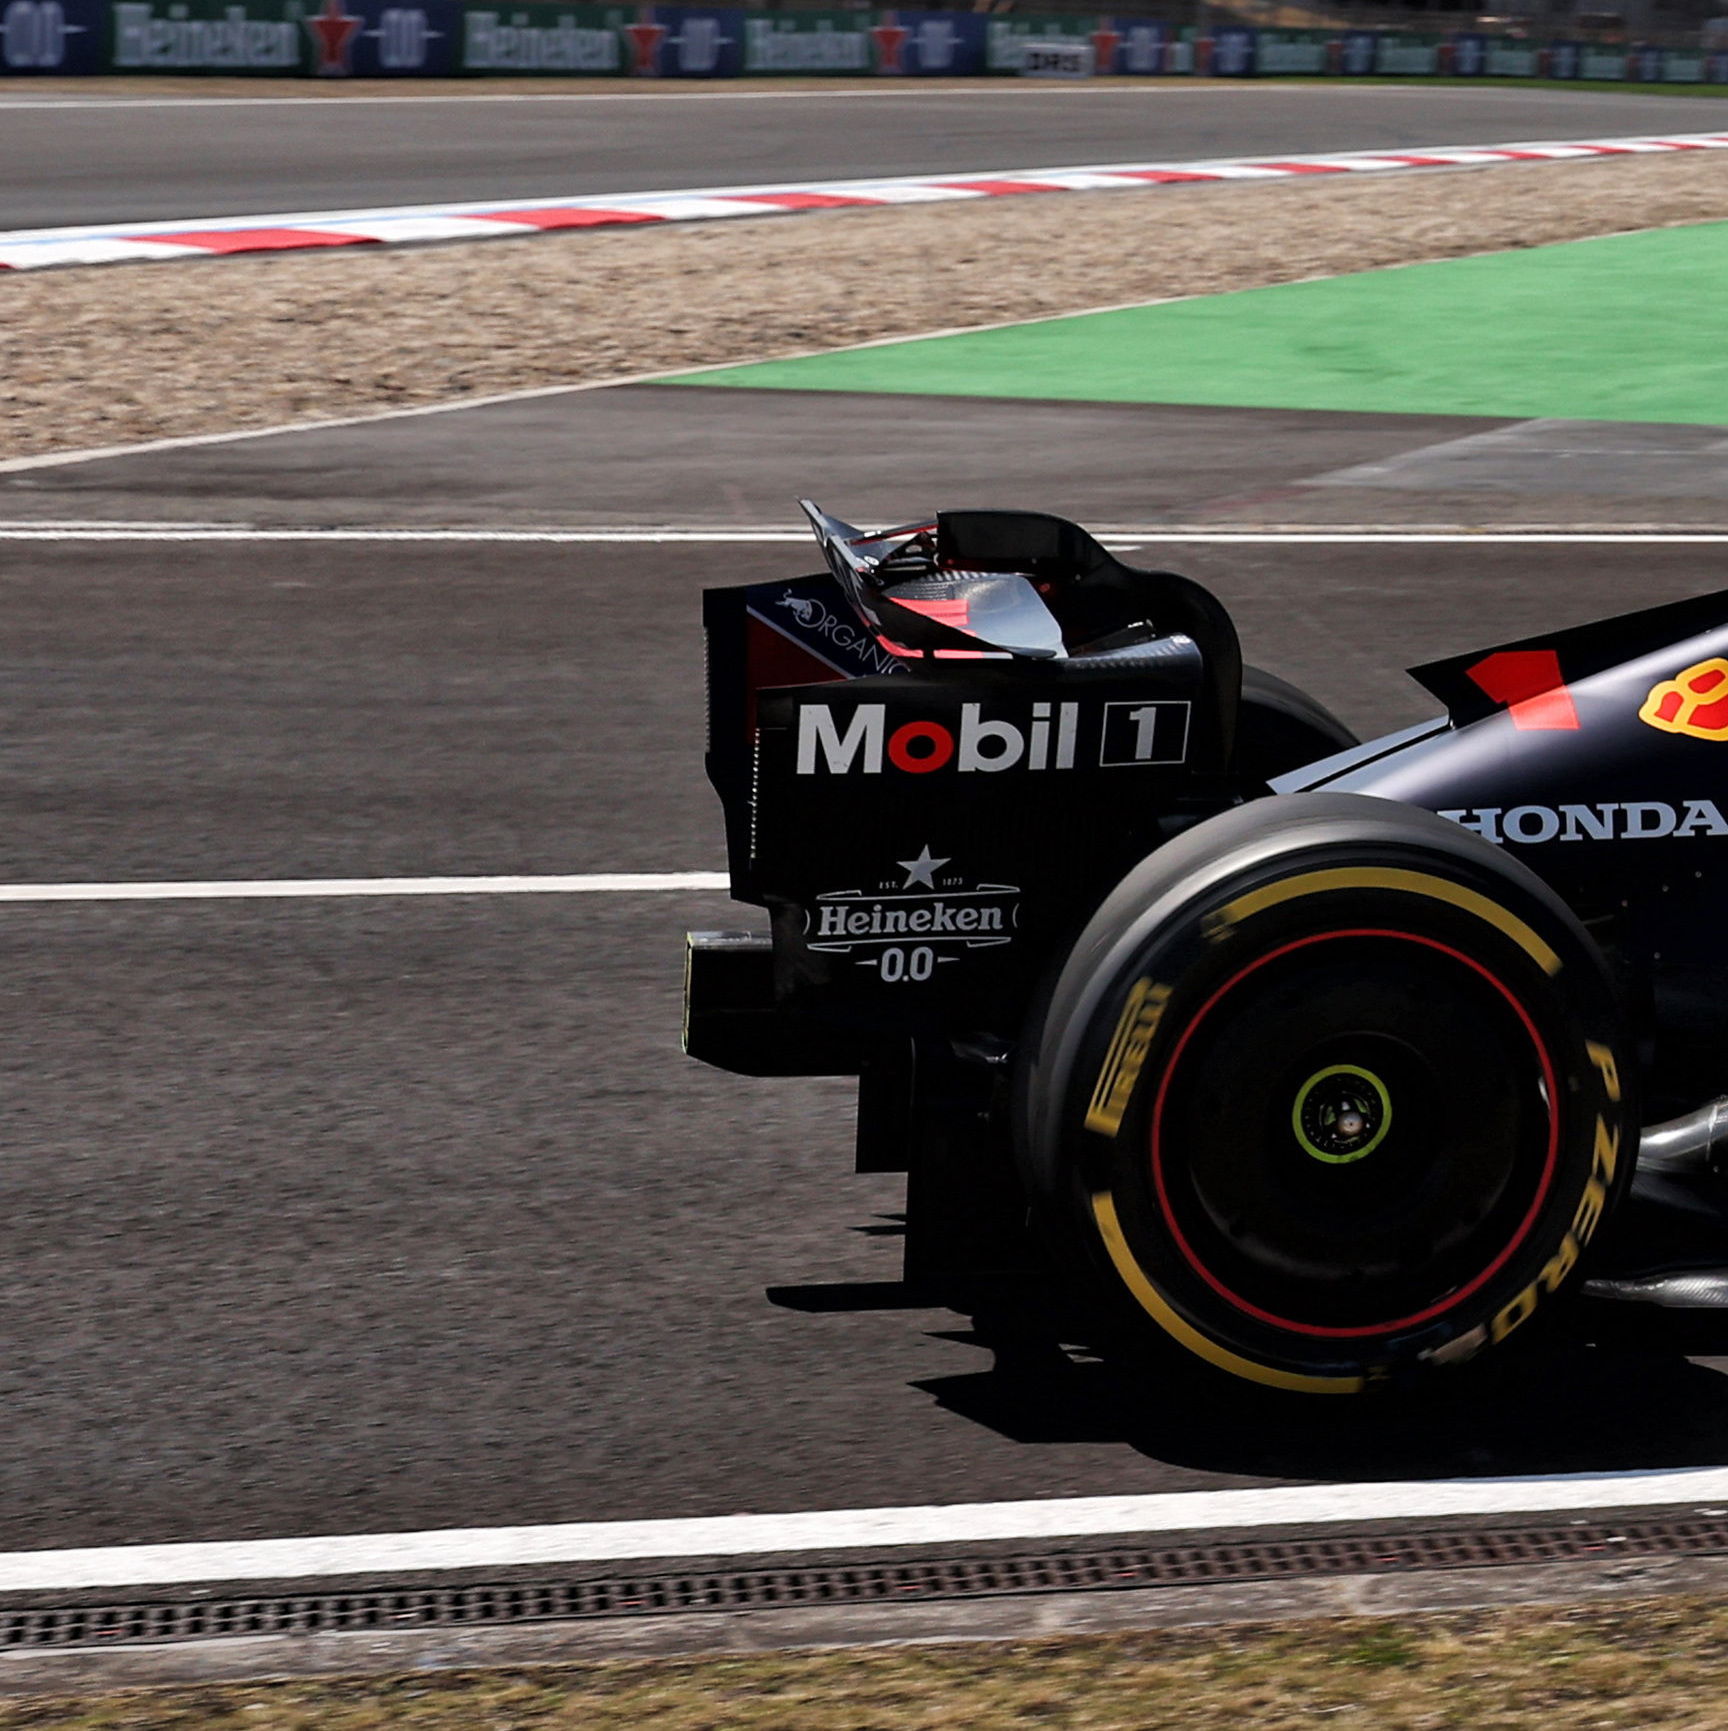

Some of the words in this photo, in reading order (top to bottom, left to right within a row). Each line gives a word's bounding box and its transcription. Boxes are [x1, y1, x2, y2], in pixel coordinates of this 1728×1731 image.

[796, 702, 1078, 774] Mobil
[1128, 707, 1157, 760] 1
[817, 902, 1004, 935] Heineken
[880, 946, 934, 982] 0.0
